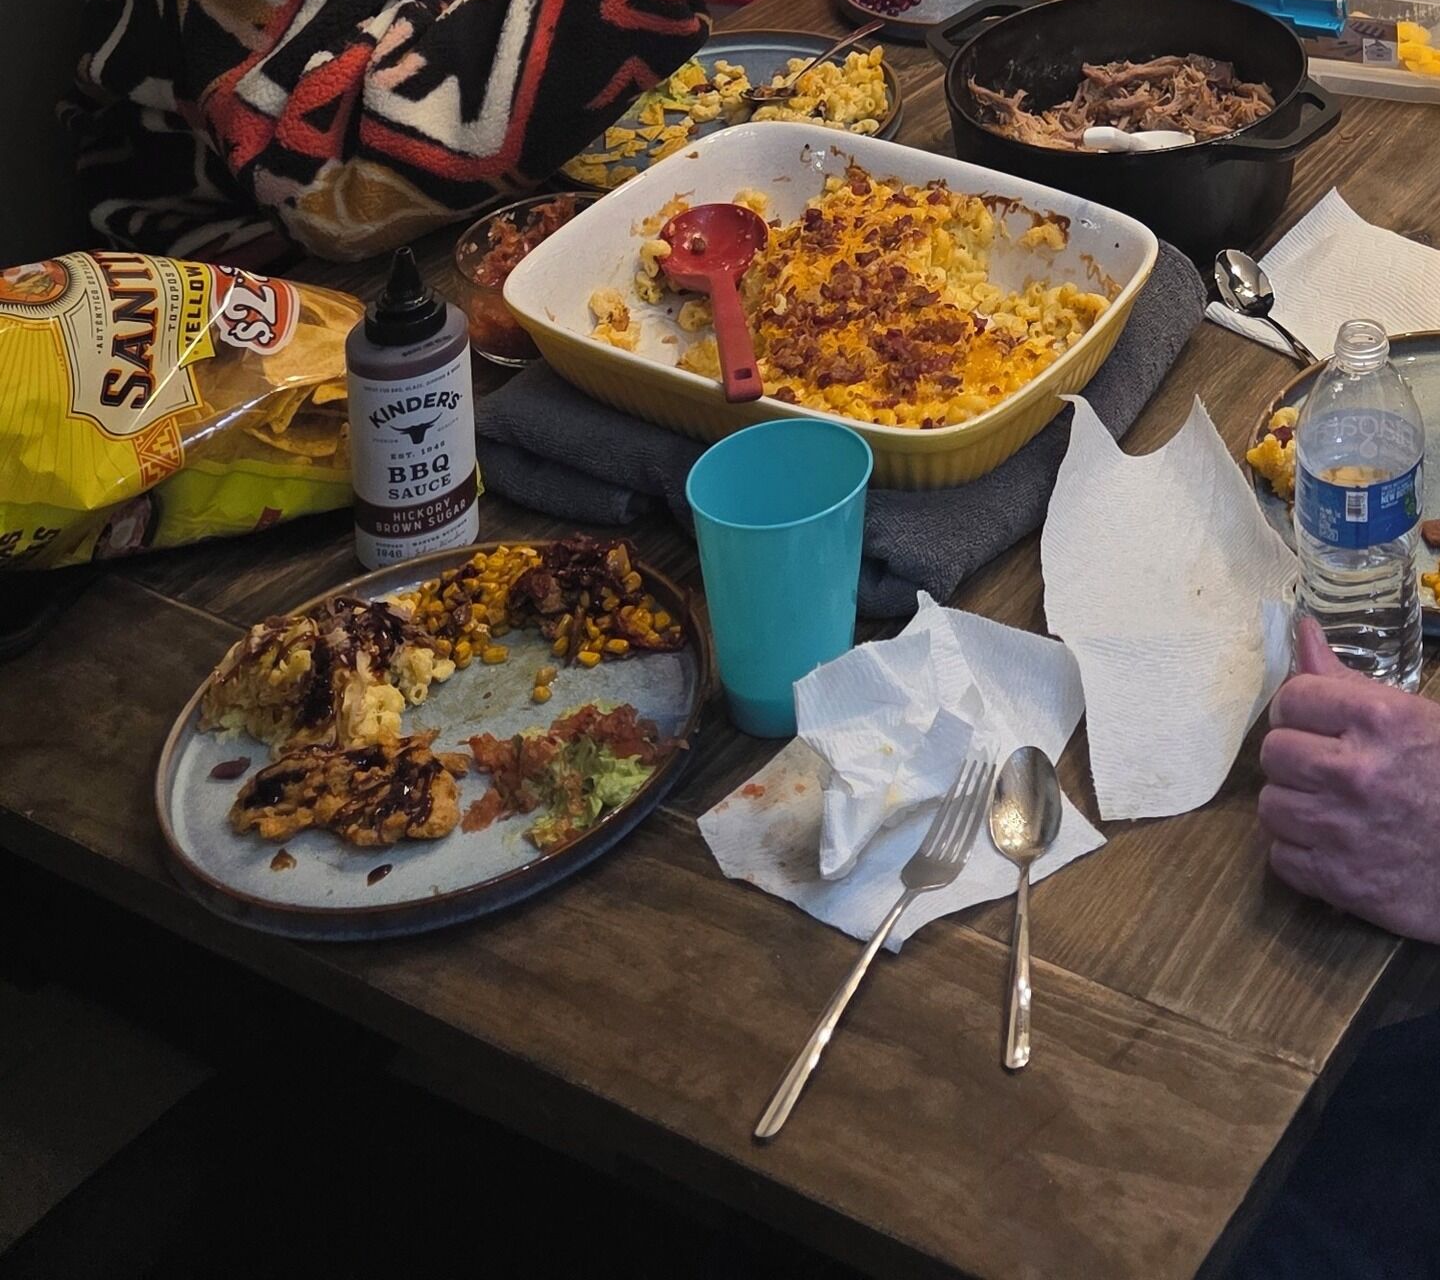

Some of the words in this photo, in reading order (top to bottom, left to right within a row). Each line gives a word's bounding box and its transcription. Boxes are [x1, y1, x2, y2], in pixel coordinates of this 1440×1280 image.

[165, 272, 180, 332] TOTOPOS
[184, 265, 205, 348] YELLOW
[92, 251, 159, 409] SANTI
[369, 391, 460, 429] KINDER'S
[387, 453, 450, 484] BBQ
[388, 473, 451, 500] SAUCE
[375, 520, 422, 534] BROWN
[428, 498, 466, 527] SUGAR
[393, 498, 450, 522] HICKORY
